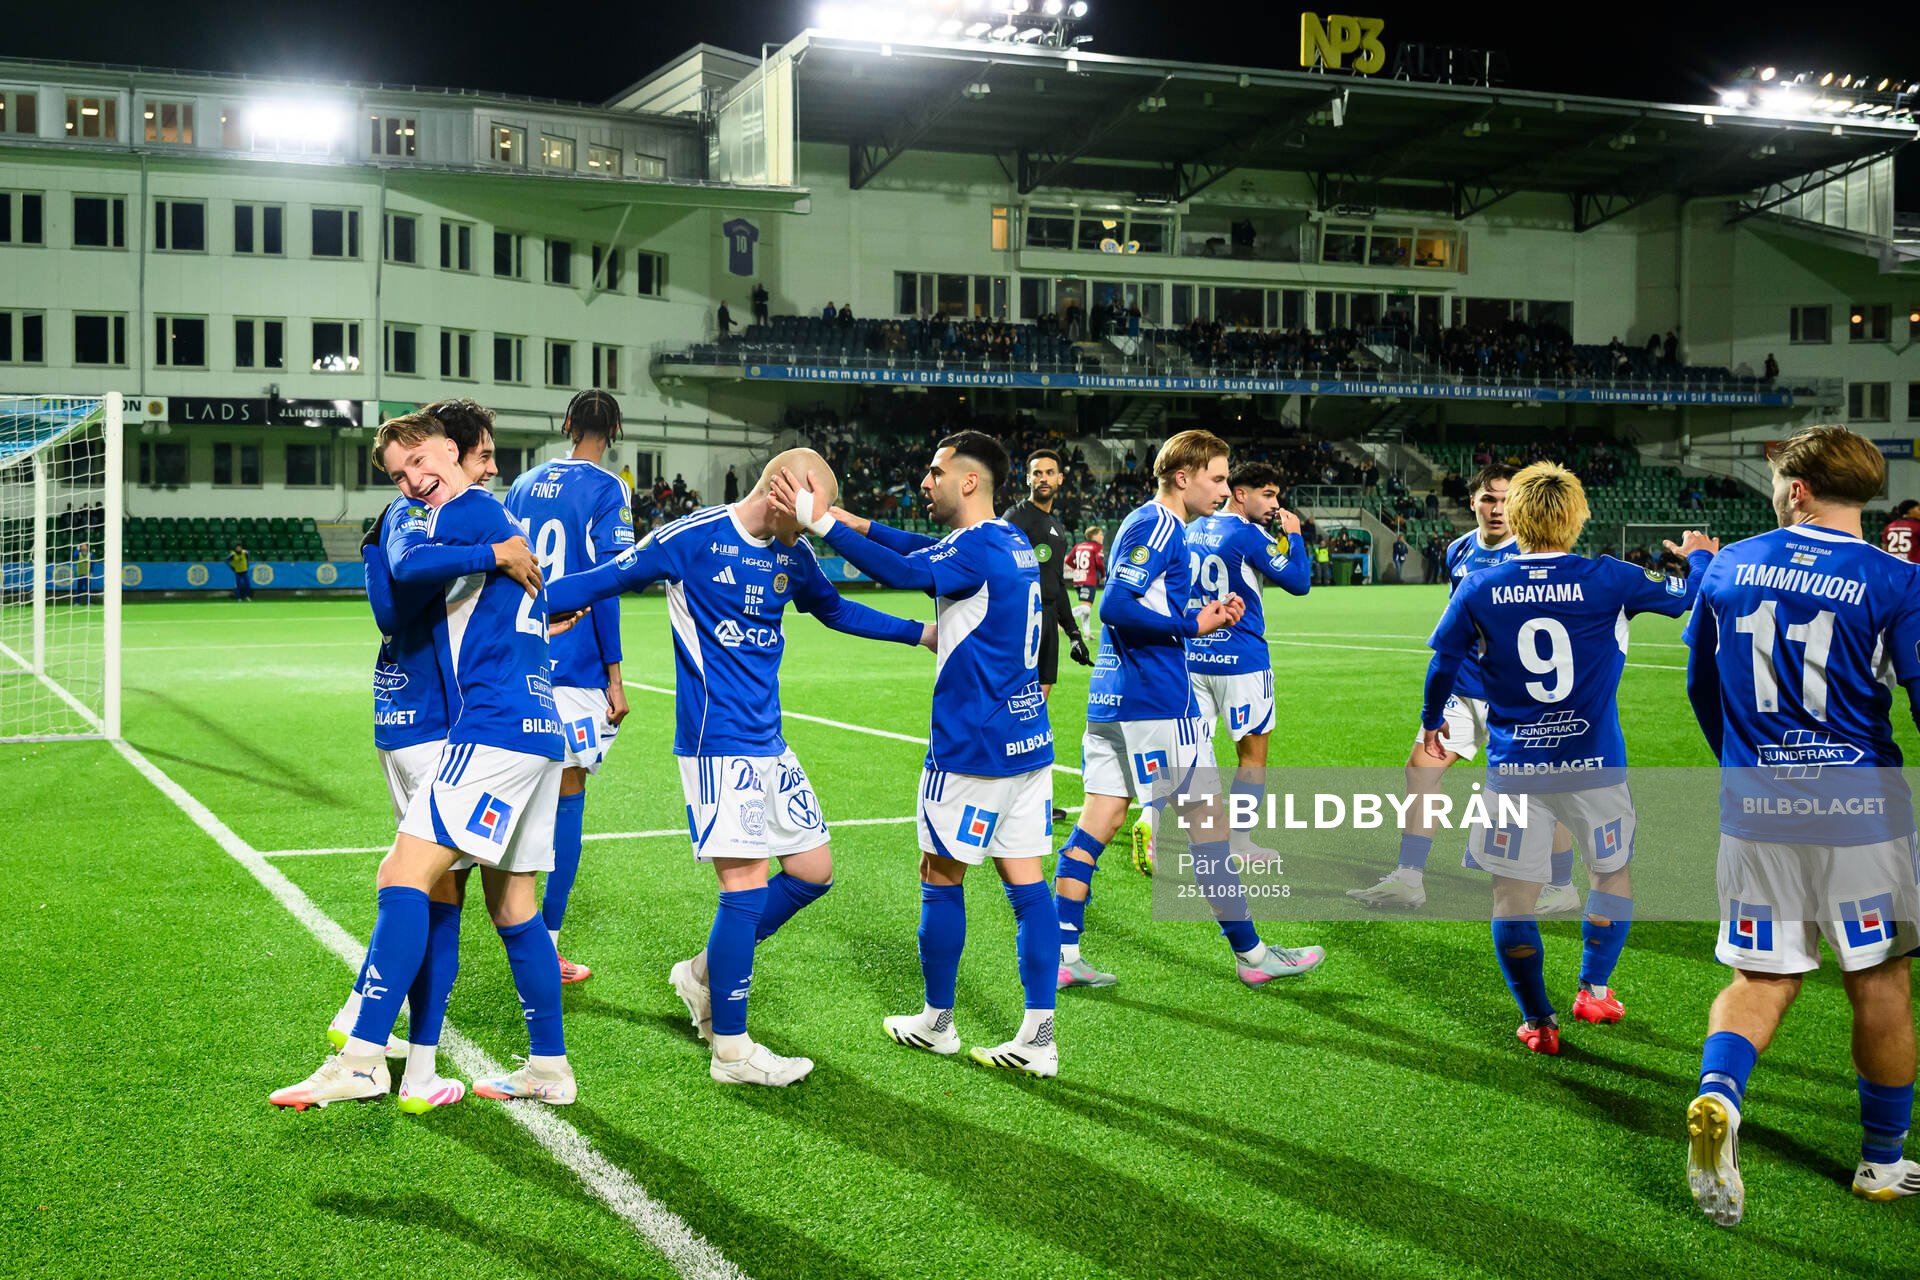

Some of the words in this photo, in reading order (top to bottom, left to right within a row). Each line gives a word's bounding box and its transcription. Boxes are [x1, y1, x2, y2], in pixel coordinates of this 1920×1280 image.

[1300, 11, 1386, 74] NP3
[736, 235, 748, 254] 10
[786, 367, 877, 381] Tillsammans
[883, 369, 896, 381] är
[902, 371, 915, 381] vi
[920, 372, 941, 382] GIF
[947, 372, 1015, 384] Sundsvall
[1078, 376, 1160, 388] Tillsammans
[1165, 378, 1178, 388] är
[1183, 379, 1194, 388] vi
[1200, 379, 1219, 389] GIF
[1224, 380, 1285, 391] Sundsvall
[1344, 383, 1418, 394] Tillsammans
[1439, 385, 1450, 395] vi
[1454, 386, 1472, 396] GIF
[1476, 387, 1532, 398] Sundsvall
[185, 403, 250, 421] LADS
[530, 482, 563, 499] FINEY
[1887, 531, 1912, 553] 25
[520, 517, 566, 586] 9
[777, 553, 789, 566] NP3
[1039, 548, 1046, 558] S
[1074, 550, 1090, 570] 16
[742, 557, 773, 569] HIGHCON
[745, 584, 764, 595] SUN
[1734, 563, 1867, 606] TAMMIVUORI
[1492, 583, 1584, 605] KAGAYAMA
[743, 605, 760, 615] ALL
[1024, 581, 1042, 669] 6
[745, 628, 778, 647] SCA
[1186, 652, 1239, 665] BOLAGET
[1517, 617, 1575, 703] 9
[1735, 600, 1836, 722] 11
[375, 710, 417, 725] OLAGET
[1520, 723, 1579, 736] SUNDFRAKT
[1006, 728, 1054, 757] BILBOLA
[1763, 749, 1845, 761] SUNDFRAKT
[1498, 757, 1605, 776] BILBOLAGET
[1742, 797, 1886, 815] BILBOLAGET
